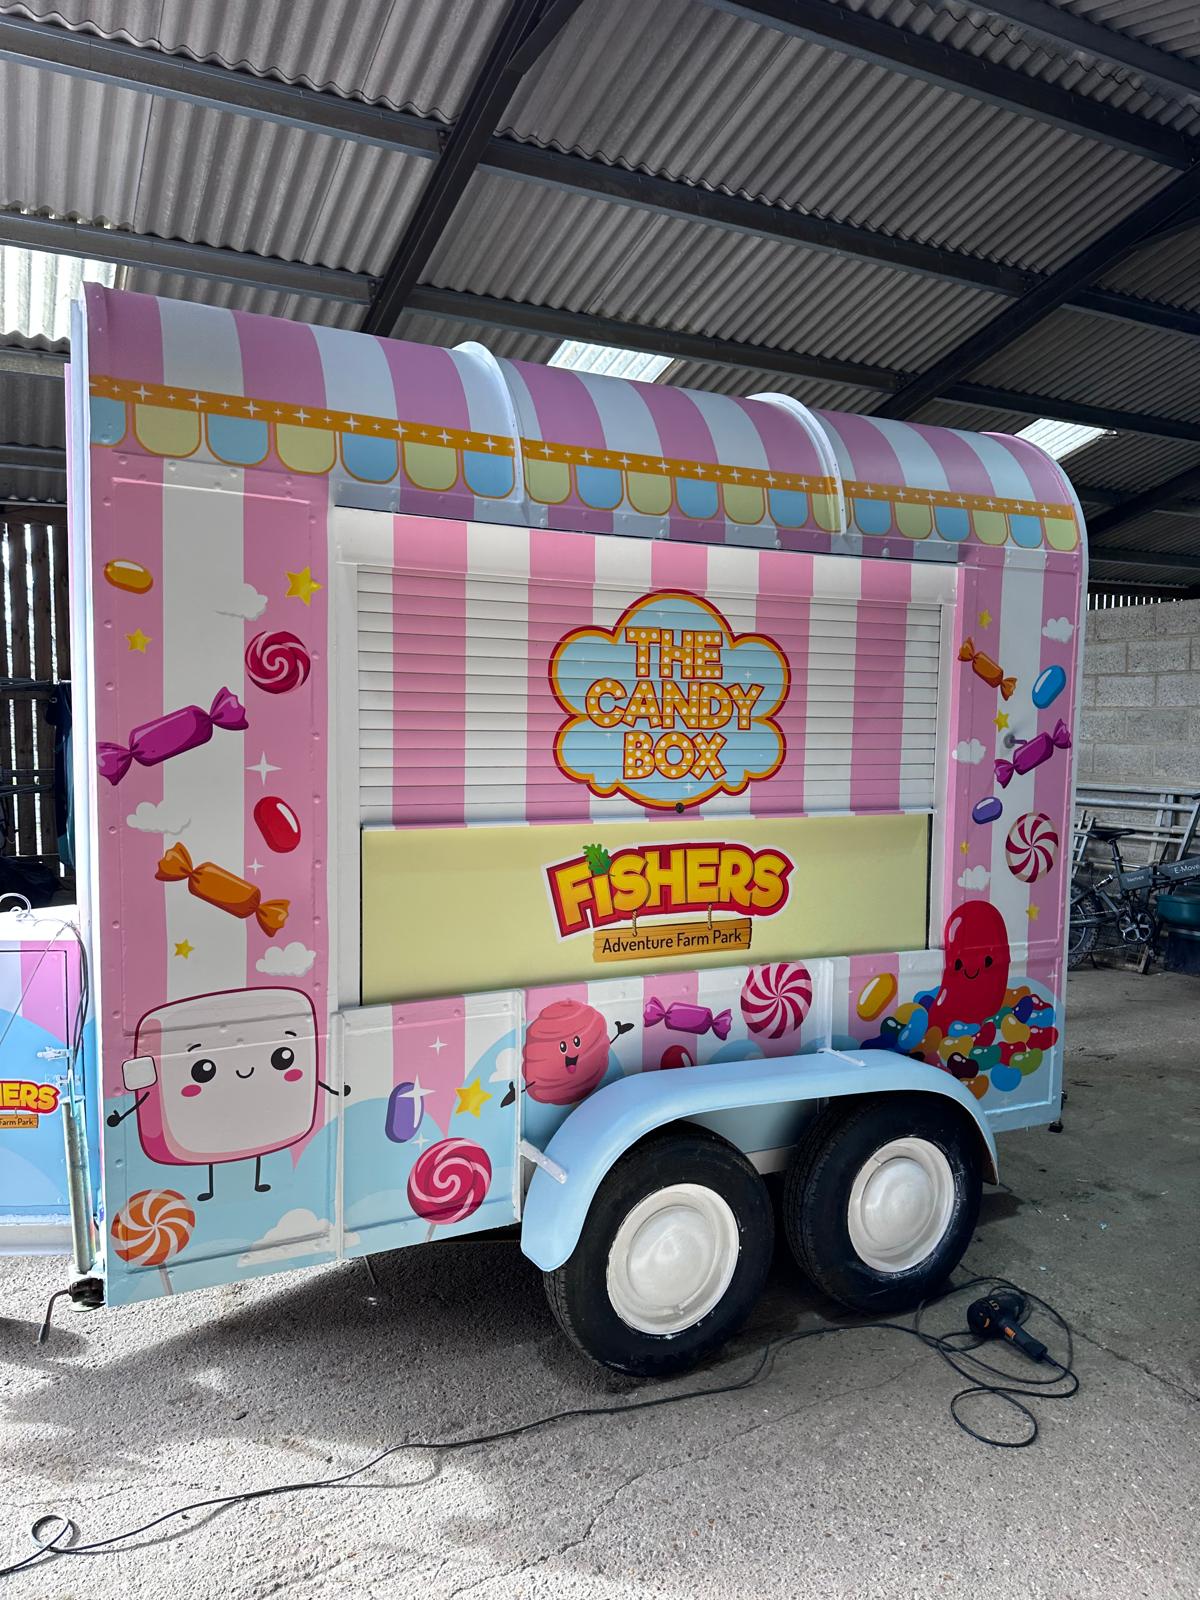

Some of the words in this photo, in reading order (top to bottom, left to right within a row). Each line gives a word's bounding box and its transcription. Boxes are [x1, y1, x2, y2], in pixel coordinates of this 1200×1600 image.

[625, 627, 722, 679] THE
[585, 678, 764, 730] CANDY
[623, 731, 726, 780] BOX
[602, 936, 673, 954] Adventure
[677, 932, 709, 947] Farm
[713, 928, 742, 944] Park
[0, 1082, 56, 1110] ERS
[0, 1118, 16, 1126] arm
[17, 1117, 33, 1126] Park
